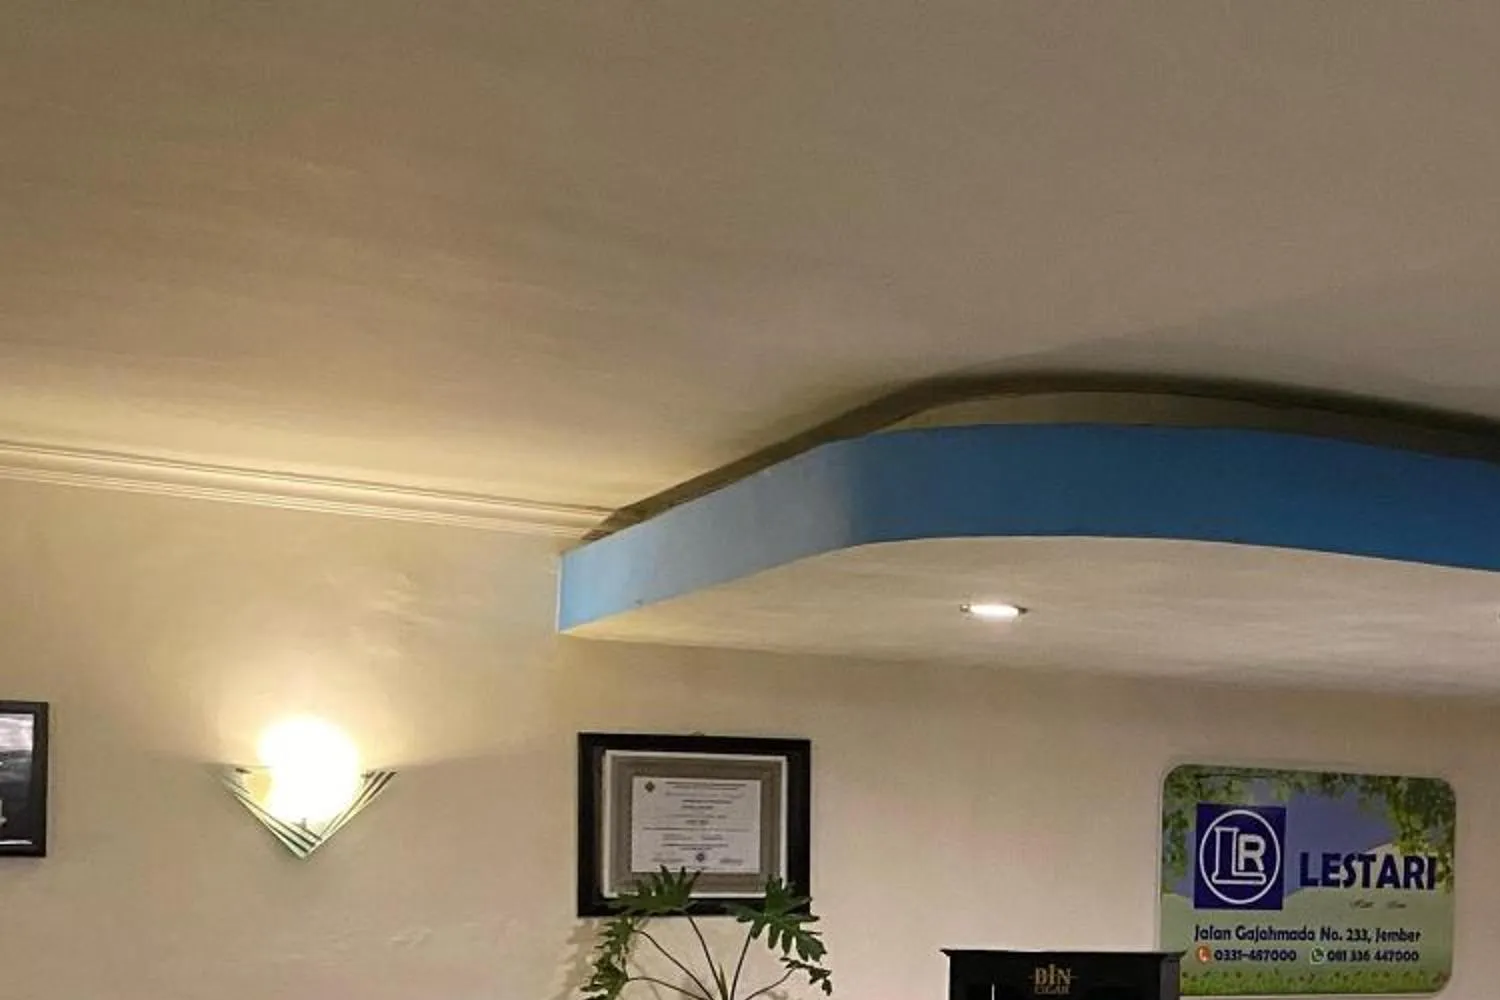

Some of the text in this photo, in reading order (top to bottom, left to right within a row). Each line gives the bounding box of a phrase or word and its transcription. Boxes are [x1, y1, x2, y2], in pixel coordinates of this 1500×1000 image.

[1299, 851, 1438, 891] LESTARI
[1194, 924, 1421, 944] Jalan Gajahmada No. 233, Jember
